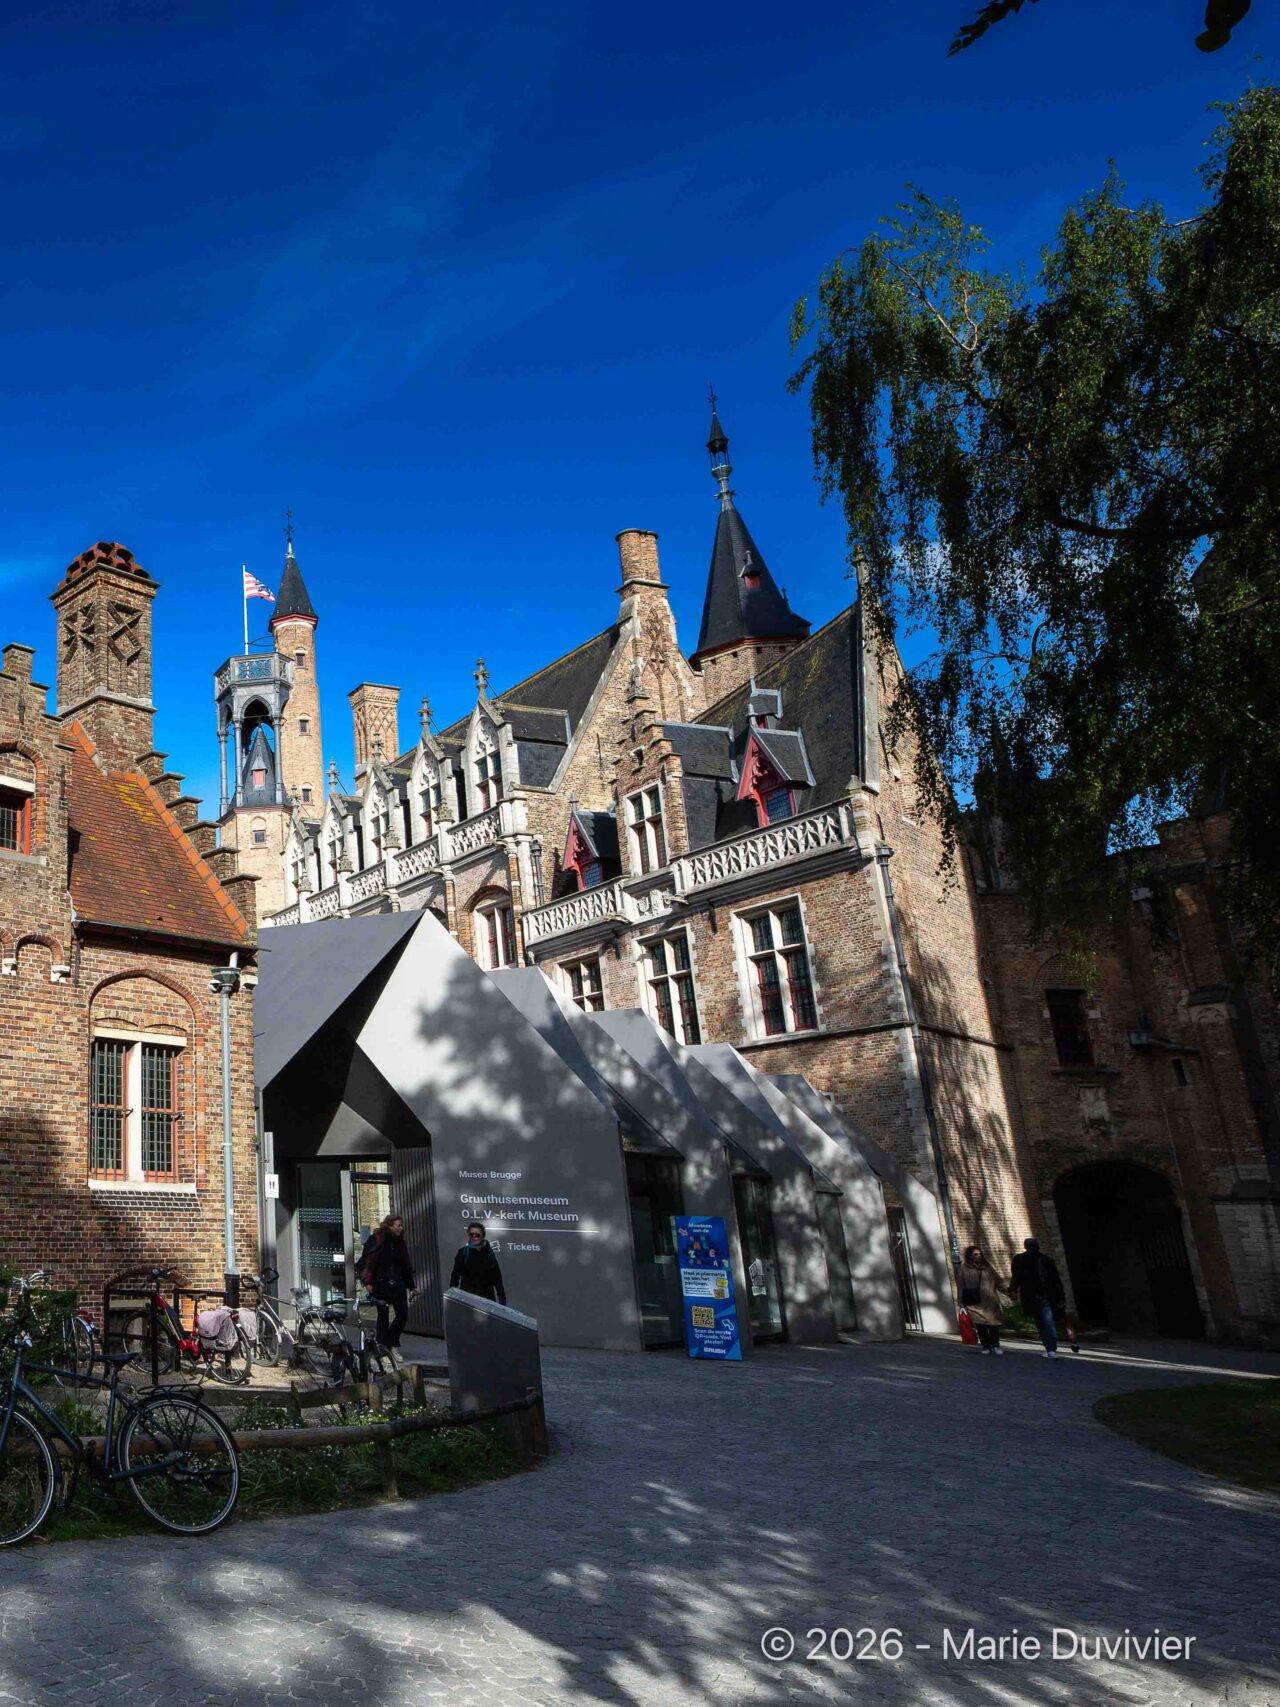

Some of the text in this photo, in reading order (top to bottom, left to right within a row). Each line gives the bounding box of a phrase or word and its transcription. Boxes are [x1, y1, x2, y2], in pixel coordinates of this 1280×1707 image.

[458, 1170, 522, 1180] Musea Brugge
[460, 1194, 569, 1206] Gruuthusemuseum
[461, 1209, 579, 1222] O.L.V.-kerk Museum
[507, 1242, 541, 1252] Tickets
